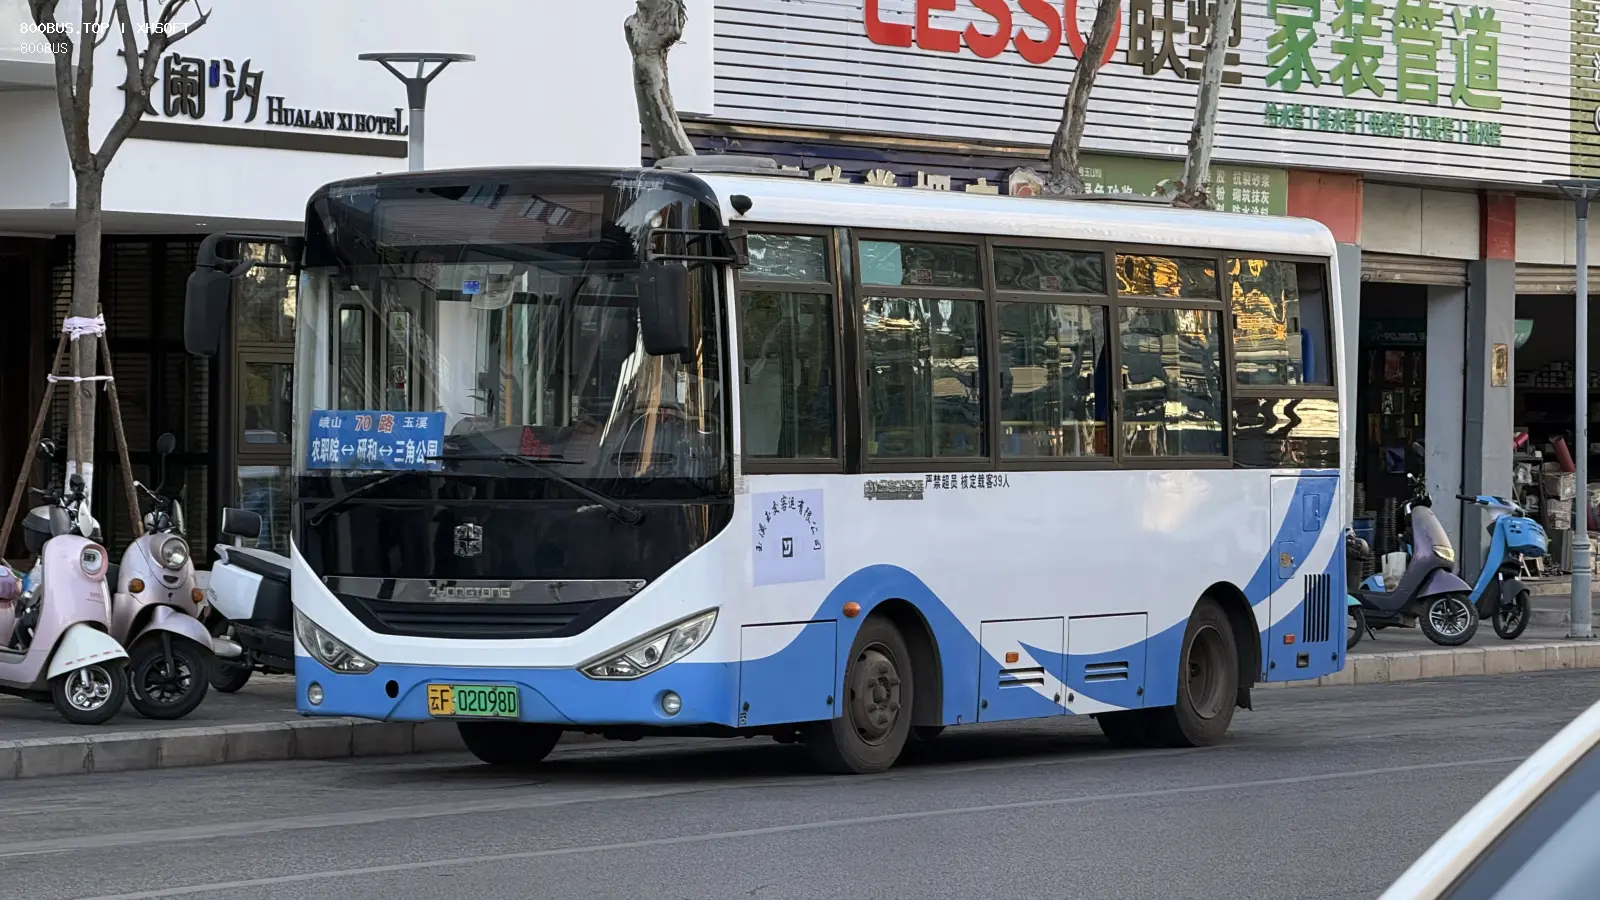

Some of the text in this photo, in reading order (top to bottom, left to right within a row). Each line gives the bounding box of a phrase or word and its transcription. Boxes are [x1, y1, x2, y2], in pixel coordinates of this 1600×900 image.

[864, 0, 1121, 65] LESSO
[1265, 0, 1502, 109] 家装管道
[265, 96, 408, 136] HUALAN XI HOTEL
[1266, 101, 1304, 128] 给水管
[1318, 105, 1357, 133] 排水管
[1232, 170, 1270, 187] 抗裂砂浆
[1232, 188, 1270, 204] 砌筑抹灰
[318, 414, 429, 433] 峨山 70 路 玉溪
[311, 438, 438, 465] 农职院 研和 三角公园
[925, 473, 1010, 489] 严禁超员 核定载客39人
[428, 586, 511, 599] ZHONGTONG
